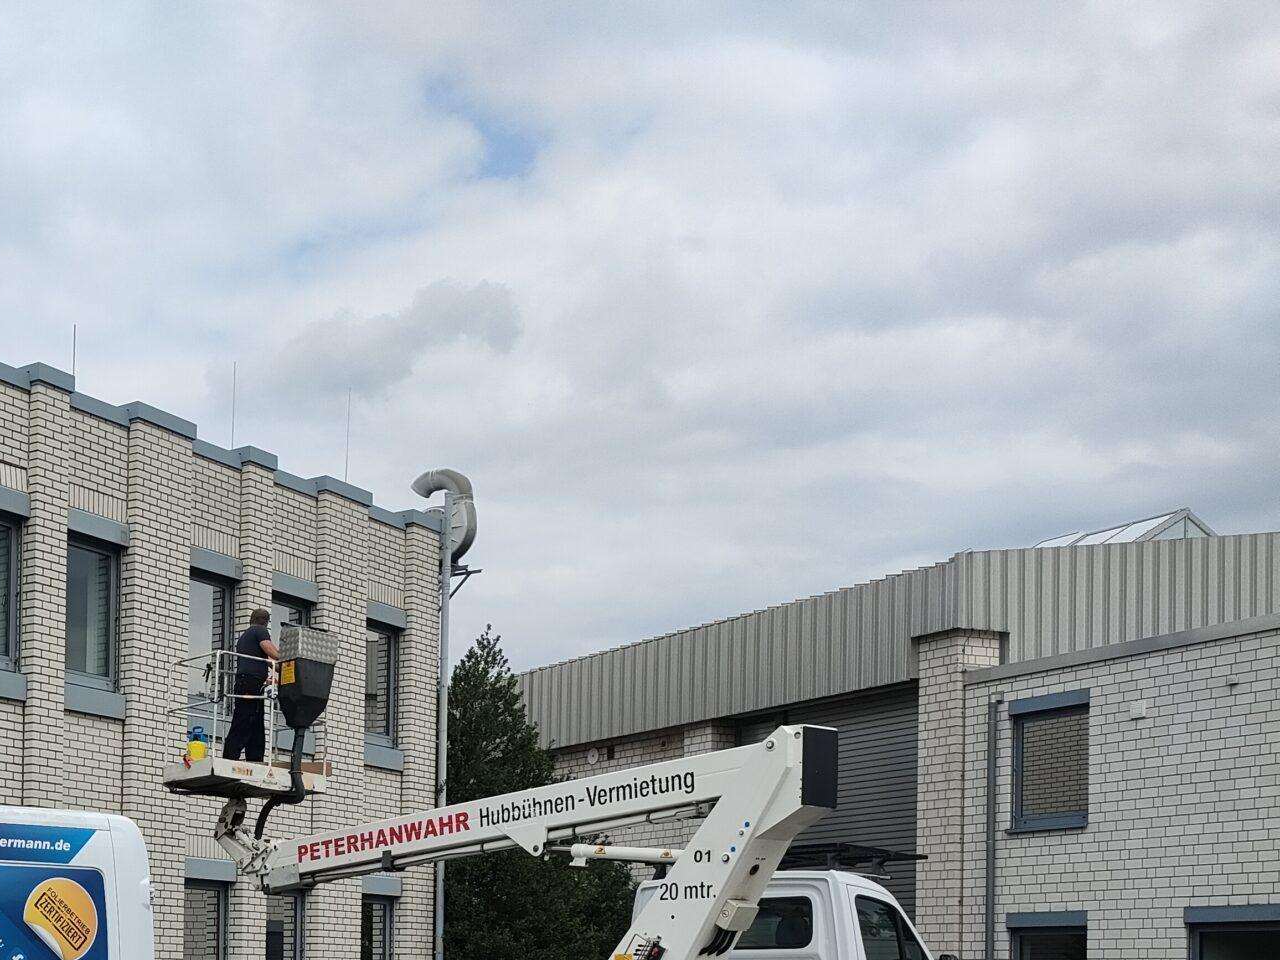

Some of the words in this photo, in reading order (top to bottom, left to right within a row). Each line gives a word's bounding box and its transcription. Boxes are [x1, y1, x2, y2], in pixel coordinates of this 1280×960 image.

[297, 811, 470, 863] PETERHANWAHR
[693, 850, 711, 863] 01
[46, 887, 91, 935] FOLIERBETRIEB
[660, 882, 679, 900] 20
[684, 881, 716, 899] mtr.
[38, 897, 82, 946] ZERTIFIZIERT
